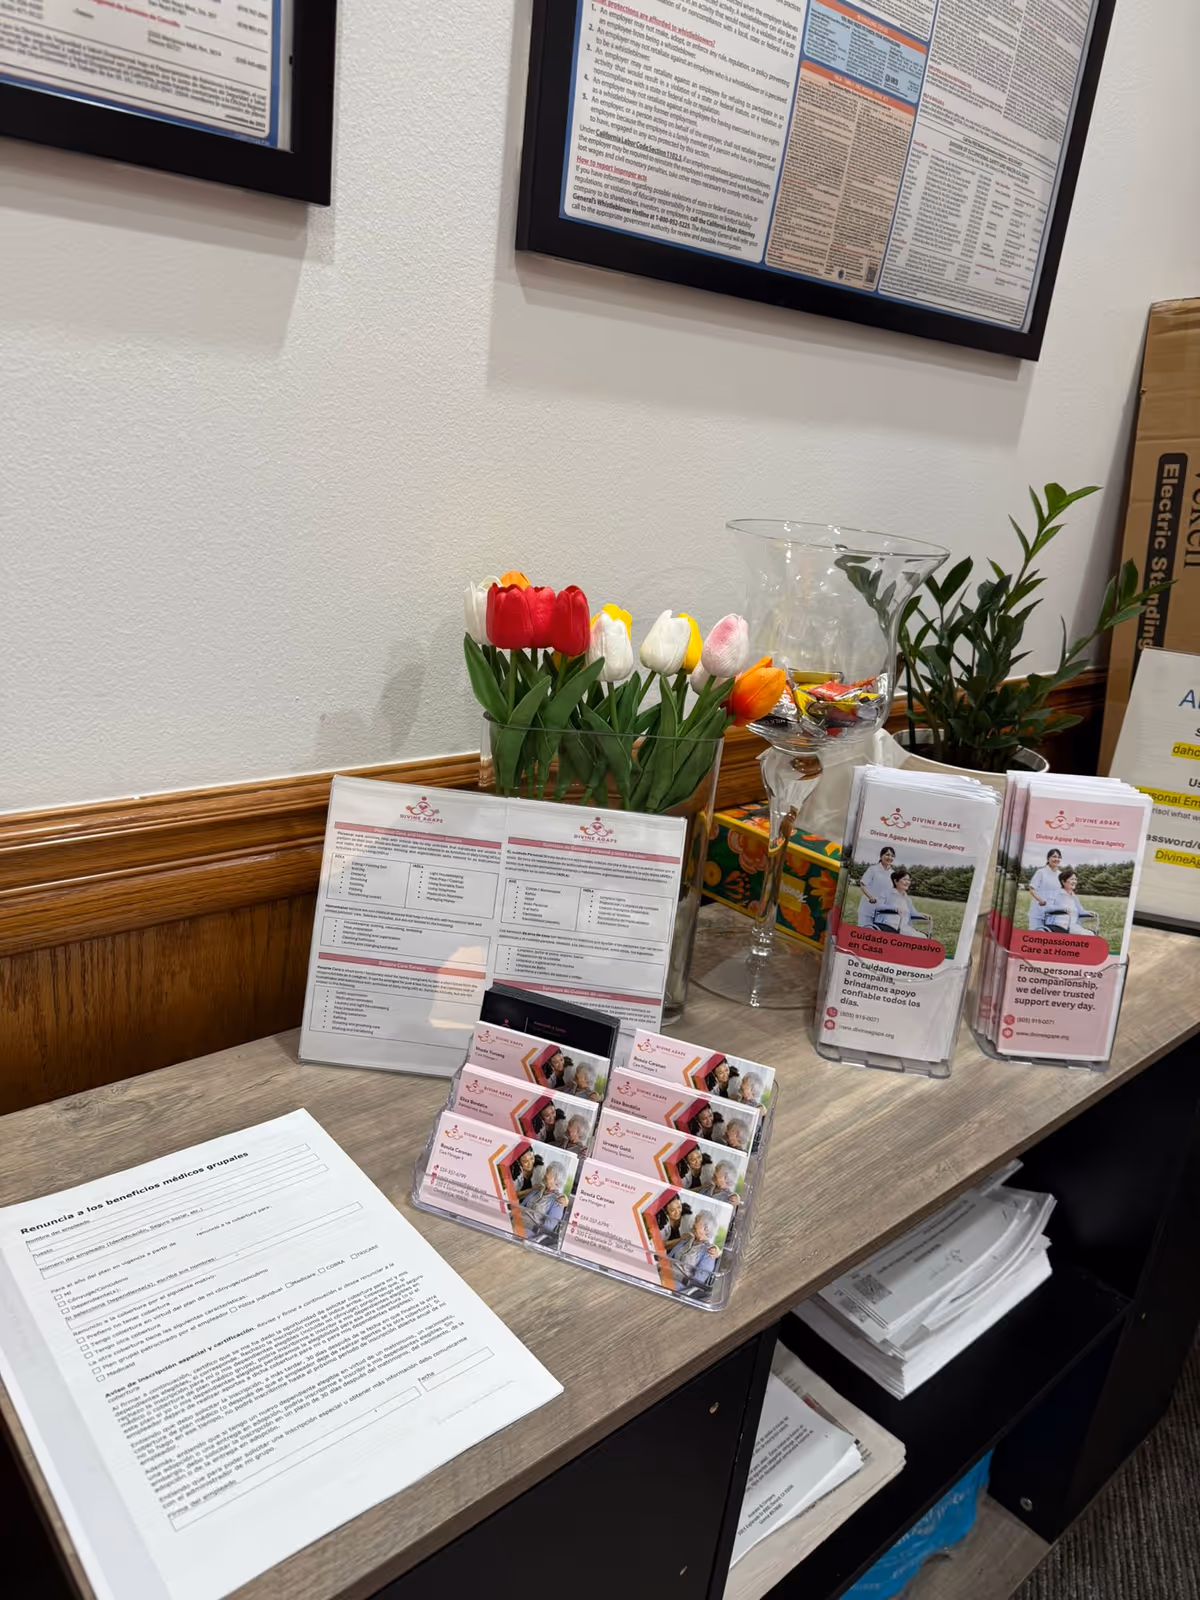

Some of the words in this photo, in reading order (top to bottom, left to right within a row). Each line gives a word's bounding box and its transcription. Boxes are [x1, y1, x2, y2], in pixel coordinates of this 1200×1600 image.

[579, 124, 595, 135] Under
[595, 128, 621, 144] California
[620, 136, 636, 148] Labor
[635, 141, 650, 152] Code
[648, 145, 667, 158] Section
[596, 162, 614, 173] report
[613, 165, 637, 180] improper
[572, 192, 596, 205] General's
[597, 199, 632, 214] Whistleblower
[631, 208, 650, 219] Hotline
[1154, 464, 1180, 550] Electric
[912, 816, 935, 825] DIVINE
[938, 821, 961, 829] AGAPE
[1171, 811, 1191, 820] what
[870, 829, 888, 838] Divine
[889, 833, 907, 842] Agape
[909, 837, 927, 845] Health
[850, 931, 888, 944] Cuidado
[890, 939, 941, 953] Compasivo
[862, 943, 883, 954] Casa
[1022, 935, 1089, 948] Compassionate
[1021, 945, 1042, 954] Care
[1054, 948, 1080, 957] Home
[848, 959, 859, 967] De
[861, 962, 895, 974] cuidado
[1019, 964, 1041, 973] From
[1043, 967, 1082, 977] personal
[844, 978, 888, 993] brindamos
[890, 988, 916, 997] apoyo
[1029, 977, 1098, 990] companionship,
[842, 988, 881, 1001] confiable
[883, 995, 907, 1006] todos
[908, 1000, 920, 1008] los
[1030, 986, 1061, 996] deliver
[1063, 990, 1095, 999] trusted
[840, 997, 859, 1007] días.
[1014, 997, 1049, 1007] support
[1051, 1001, 1076, 1011] every
[1077, 1002, 1095, 1011] day.
[605, 1177, 621, 1186] DIVINE
[621, 1183, 636, 1191] AGAPE
[20, 1214, 74, 1234] Renuncia
[86, 1204, 104, 1212] los
[105, 1183, 160, 1205] beneficios
[162, 1168, 204, 1185] médicos
[206, 1152, 248, 1170] grupales
[61, 1220, 90, 1232] empleado
[76, 1245, 105, 1258] empleado
[106, 1228, 150, 1247] (Identificación,
[149, 1220, 170, 1231] Seguro
[170, 1213, 190, 1222] Social,
[32, 1248, 54, 1259] Puesto
[325, 1259, 345, 1270] COBRA
[67, 1276, 129, 1303] Cónyuge/Concubino
[71, 1288, 121, 1310] Dependiente(s):
[86, 1326, 112, 1340] Prefiero
[122, 1315, 139, 1324] tener
[140, 1302, 170, 1317] cobertura
[105, 1386, 126, 1398] Aviso
[137, 1363, 177, 1383] inscripción
[178, 1348, 207, 1364] especial
[213, 1327, 254, 1348] certificación.
[106, 1361, 136, 1377] Medicaid
[417, 1371, 435, 1382] Fecha
